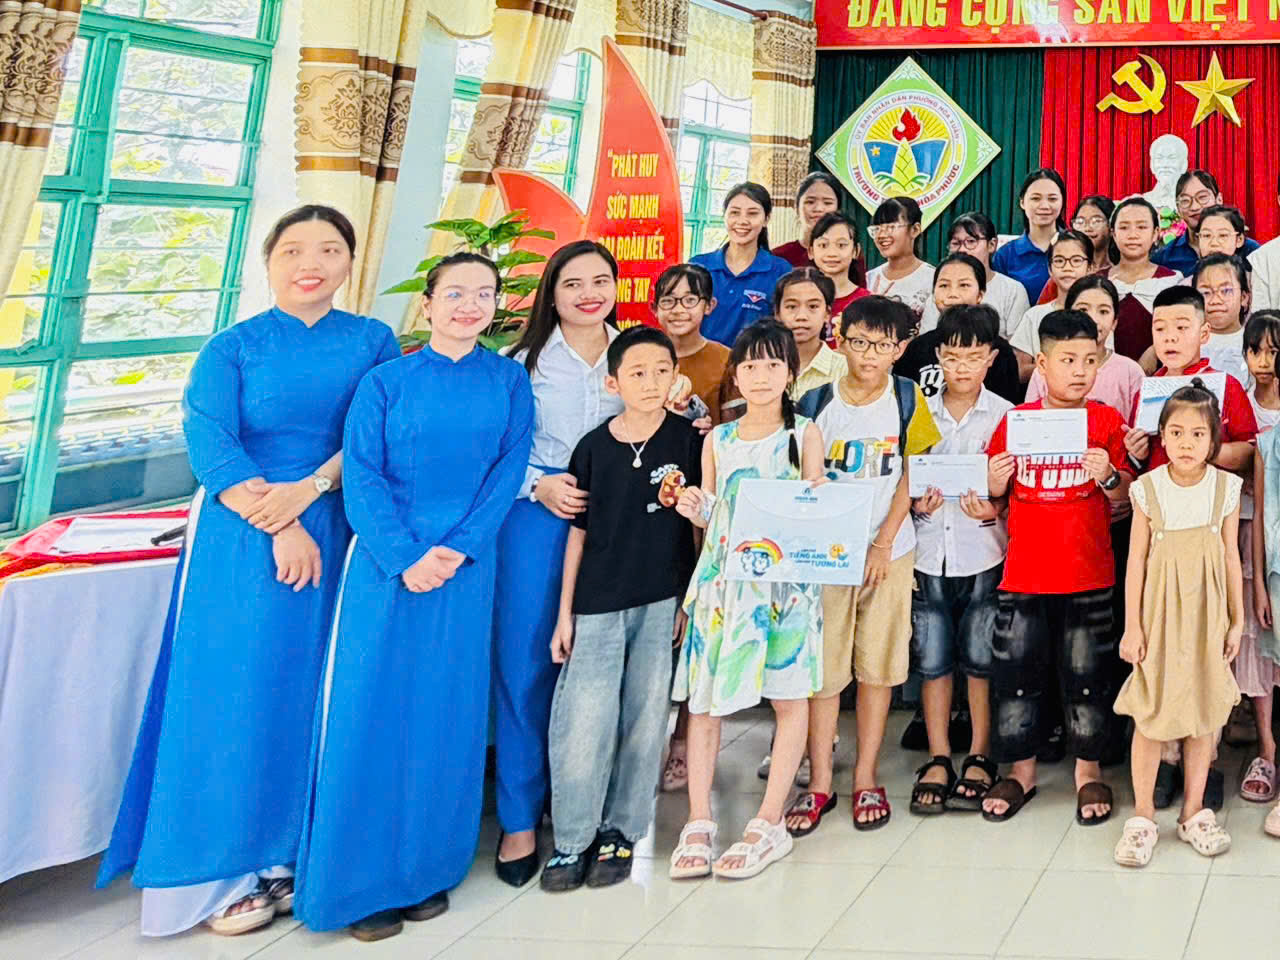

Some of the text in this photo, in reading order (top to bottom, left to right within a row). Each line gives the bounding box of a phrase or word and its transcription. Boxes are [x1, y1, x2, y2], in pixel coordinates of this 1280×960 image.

[639, 152, 660, 178] HUY
[607, 189, 660, 224] SỨC MẠNH
[633, 276, 651, 303] TAY
